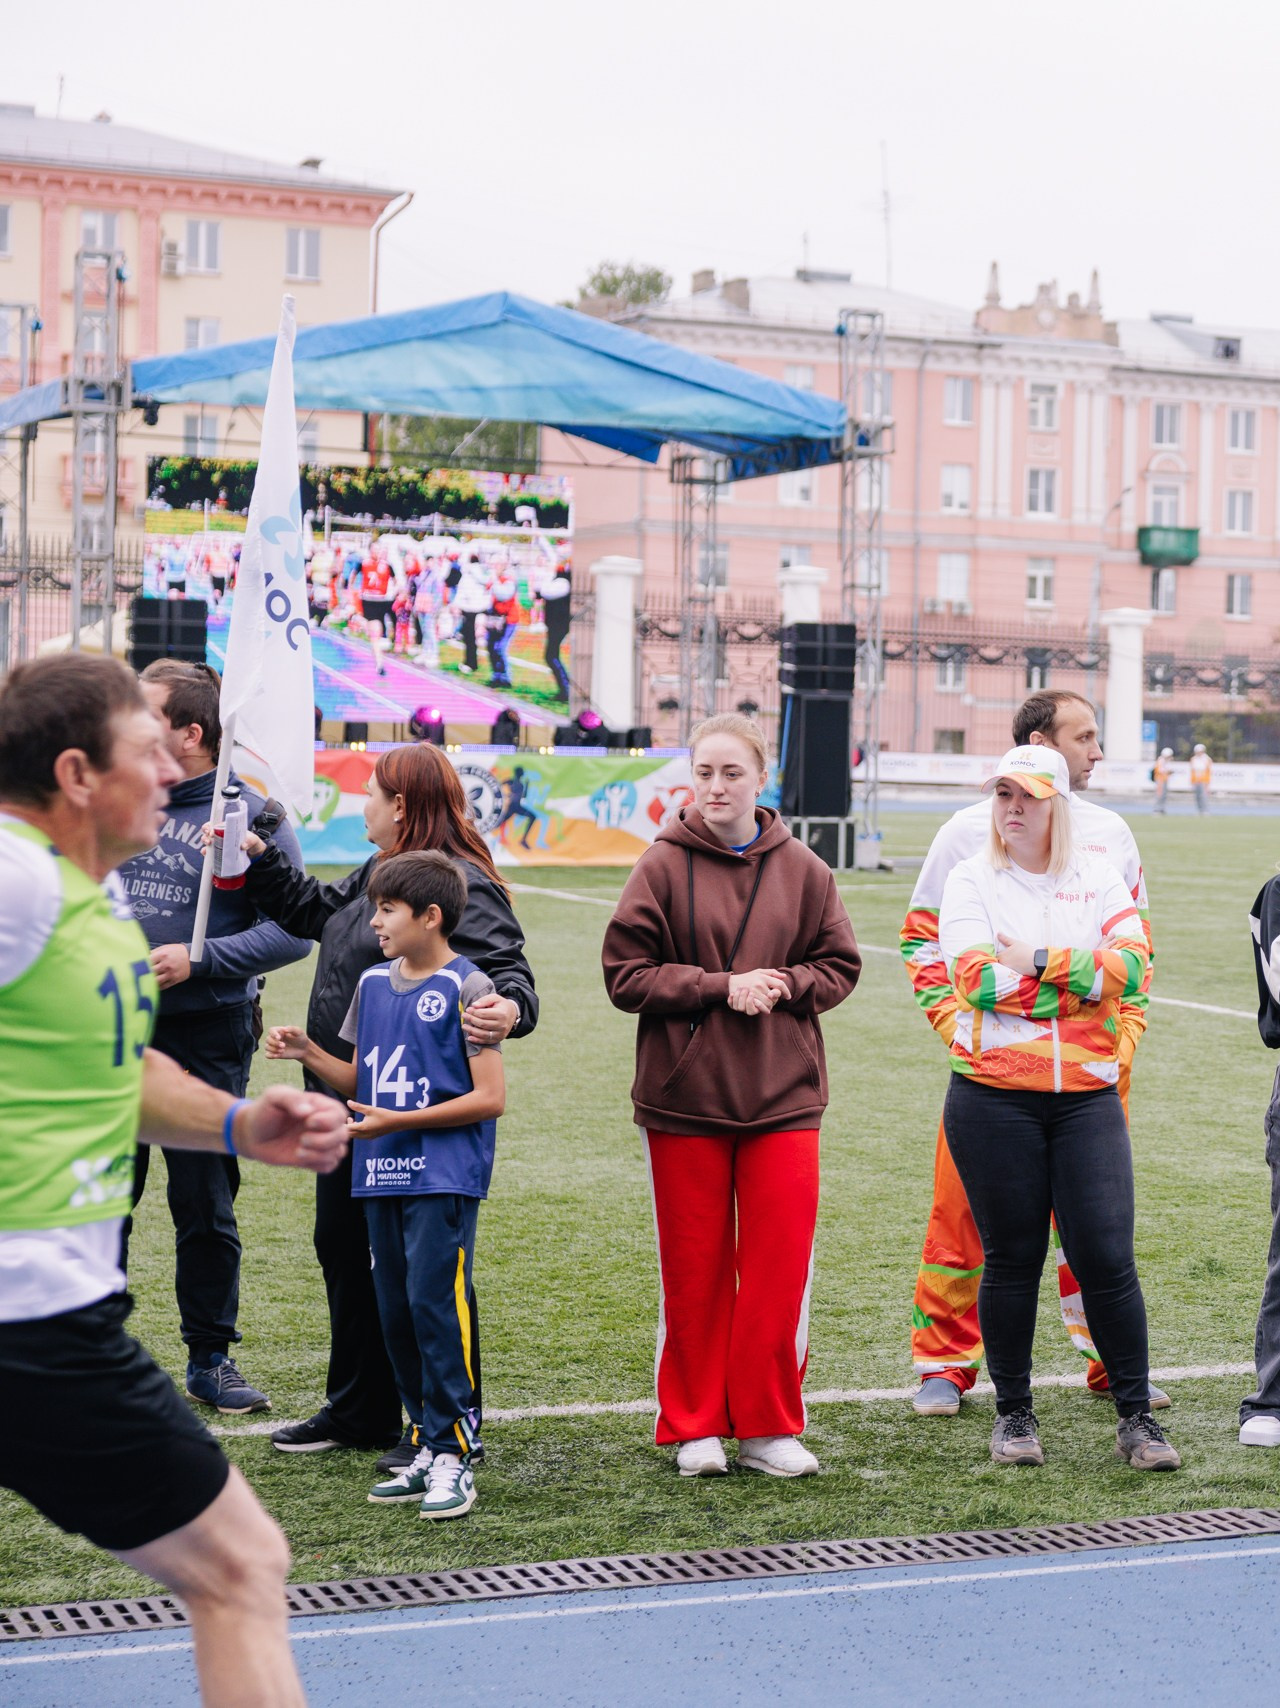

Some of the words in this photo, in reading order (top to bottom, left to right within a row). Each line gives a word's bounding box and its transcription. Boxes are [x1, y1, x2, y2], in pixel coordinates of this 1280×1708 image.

[264, 572, 310, 651] ОС
[141, 869, 160, 880] AREA
[121, 877, 192, 904] ILDERNESS
[97, 959, 154, 1067] 15
[377, 1172, 411, 1181] МИЛКОМ
